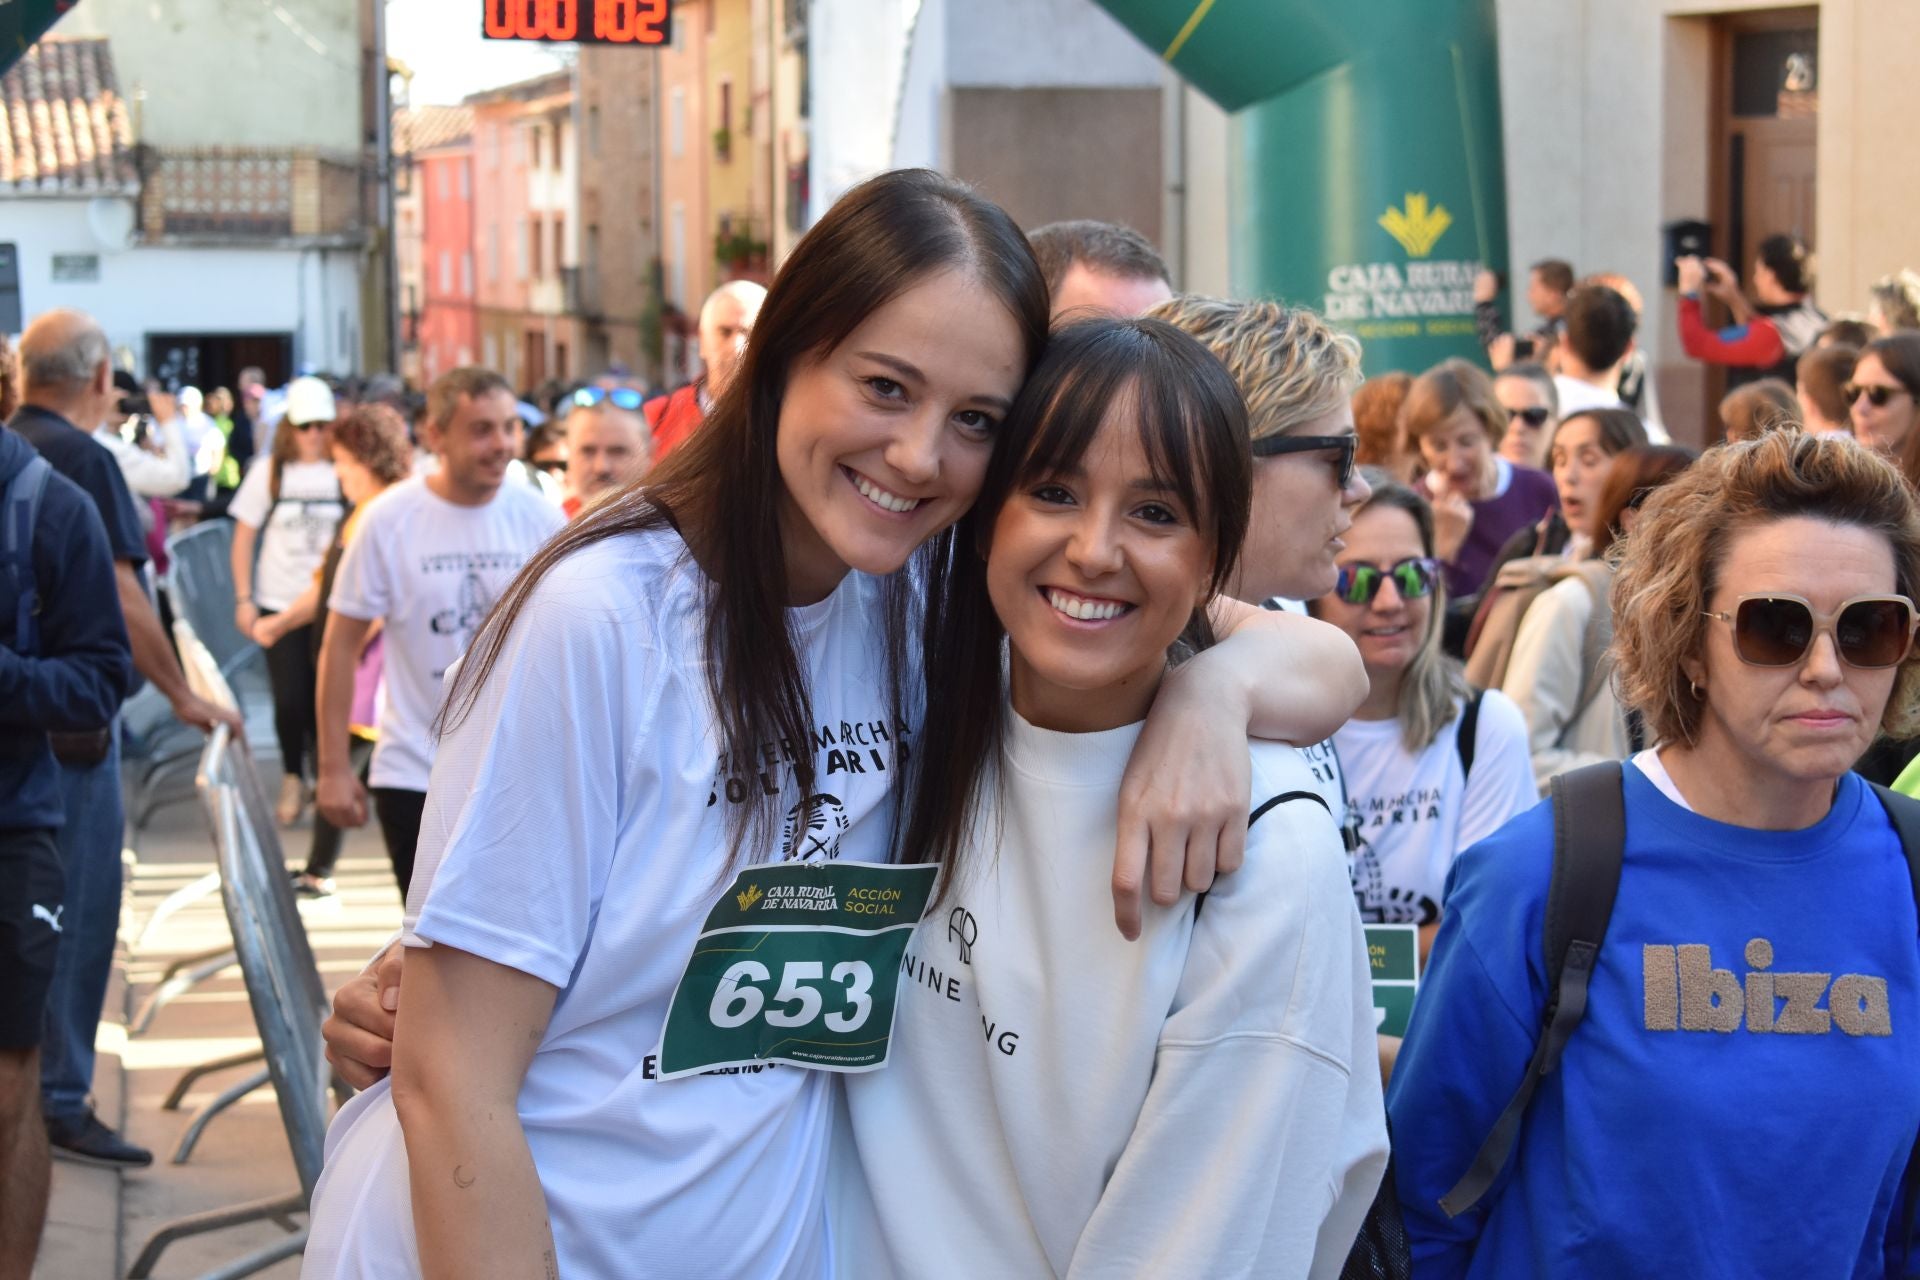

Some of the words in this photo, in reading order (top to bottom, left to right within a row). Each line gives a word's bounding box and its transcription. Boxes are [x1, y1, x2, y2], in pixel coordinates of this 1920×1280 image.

[1328, 263, 1401, 292] CAJA
[1407, 260, 1481, 288] RURA
[1325, 294, 1368, 320] DE
[1372, 290, 1475, 317] NAVAR
[768, 886, 795, 898] CAJA
[797, 886, 836, 899] RURAL
[848, 887, 901, 901] ACCIÓN
[761, 899, 778, 910] DE
[780, 898, 838, 911] NAVARRA
[844, 901, 896, 915] SOCIAL
[709, 960, 874, 1033] 653
[1643, 938, 1892, 1036] Ibiza
